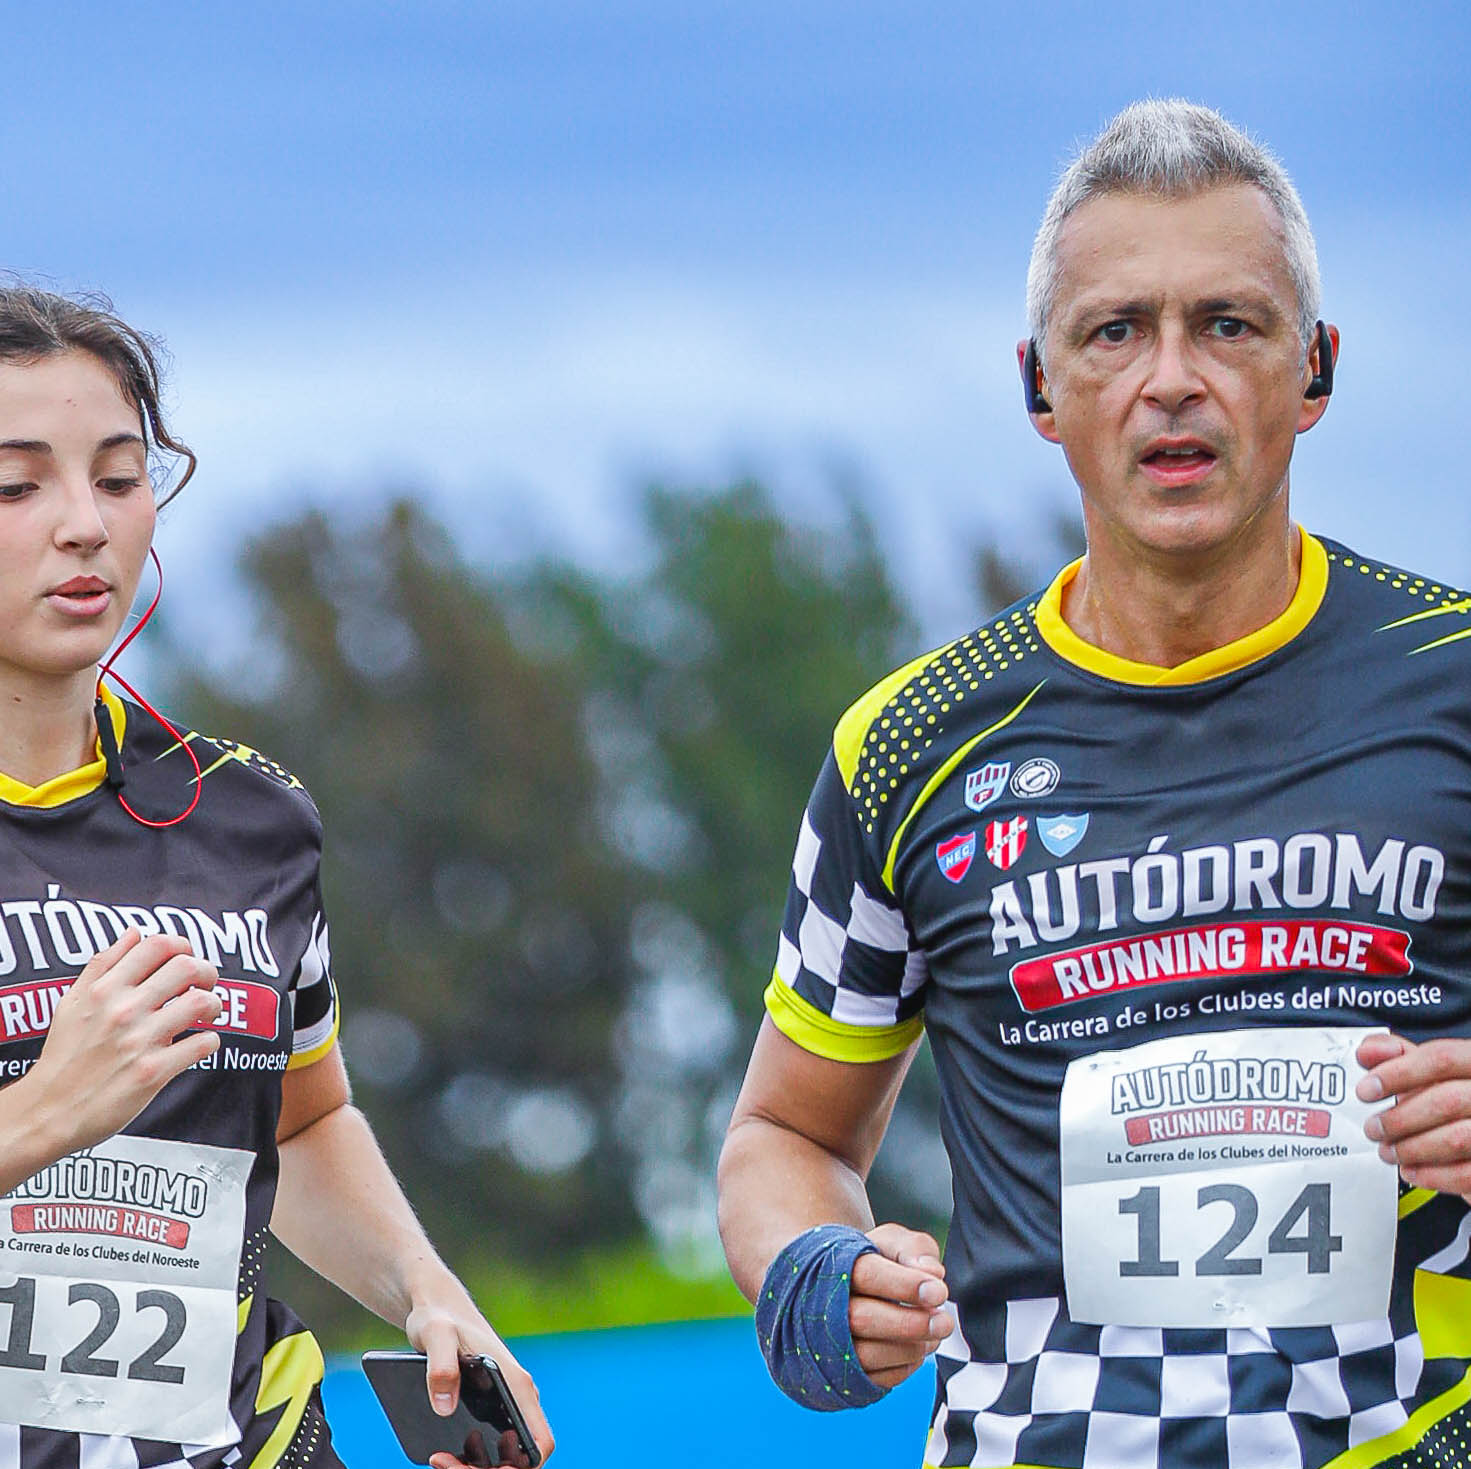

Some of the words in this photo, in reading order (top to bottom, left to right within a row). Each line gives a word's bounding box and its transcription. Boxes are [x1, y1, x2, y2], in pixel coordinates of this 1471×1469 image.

[989, 833, 1445, 956] AUTÓDROMO
[1052, 927, 1246, 999] RUNNING
[1260, 924, 1373, 971] RACE
[999, 1021, 1021, 1045] La
[1025, 1016, 1109, 1045] Carrera
[1116, 1007, 1147, 1028] de
[1155, 1002, 1190, 1022] los
[1198, 990, 1284, 1014] Clubes
[1291, 987, 1329, 1010] del
[1338, 984, 1442, 1008] Noroeste
[224, 1047, 289, 1071] Noroeste
[1111, 1051, 1345, 1114] AUTÓDROMO
[1148, 1108, 1245, 1141] RUNNING
[1252, 1109, 1307, 1135] RACE
[1106, 1151, 1122, 1164] La
[1125, 1150, 1174, 1164] Carrera
[1177, 1148, 1195, 1161] de
[1198, 1147, 1217, 1160] los
[1220, 1145, 1265, 1160] Clubes
[1267, 1144, 1288, 1158] del
[1291, 1143, 1348, 1158] Noroeste
[33, 1206, 118, 1233] RUNNING
[123, 1212, 170, 1243] RACE
[1118, 1182, 1343, 1278] 124
[8, 1238, 53, 1255] Carrera
[56, 1243, 71, 1257] de
[73, 1243, 89, 1258] los
[92, 1246, 130, 1262] Clubes
[132, 1249, 149, 1264] del
[152, 1254, 200, 1270] Noroeste
